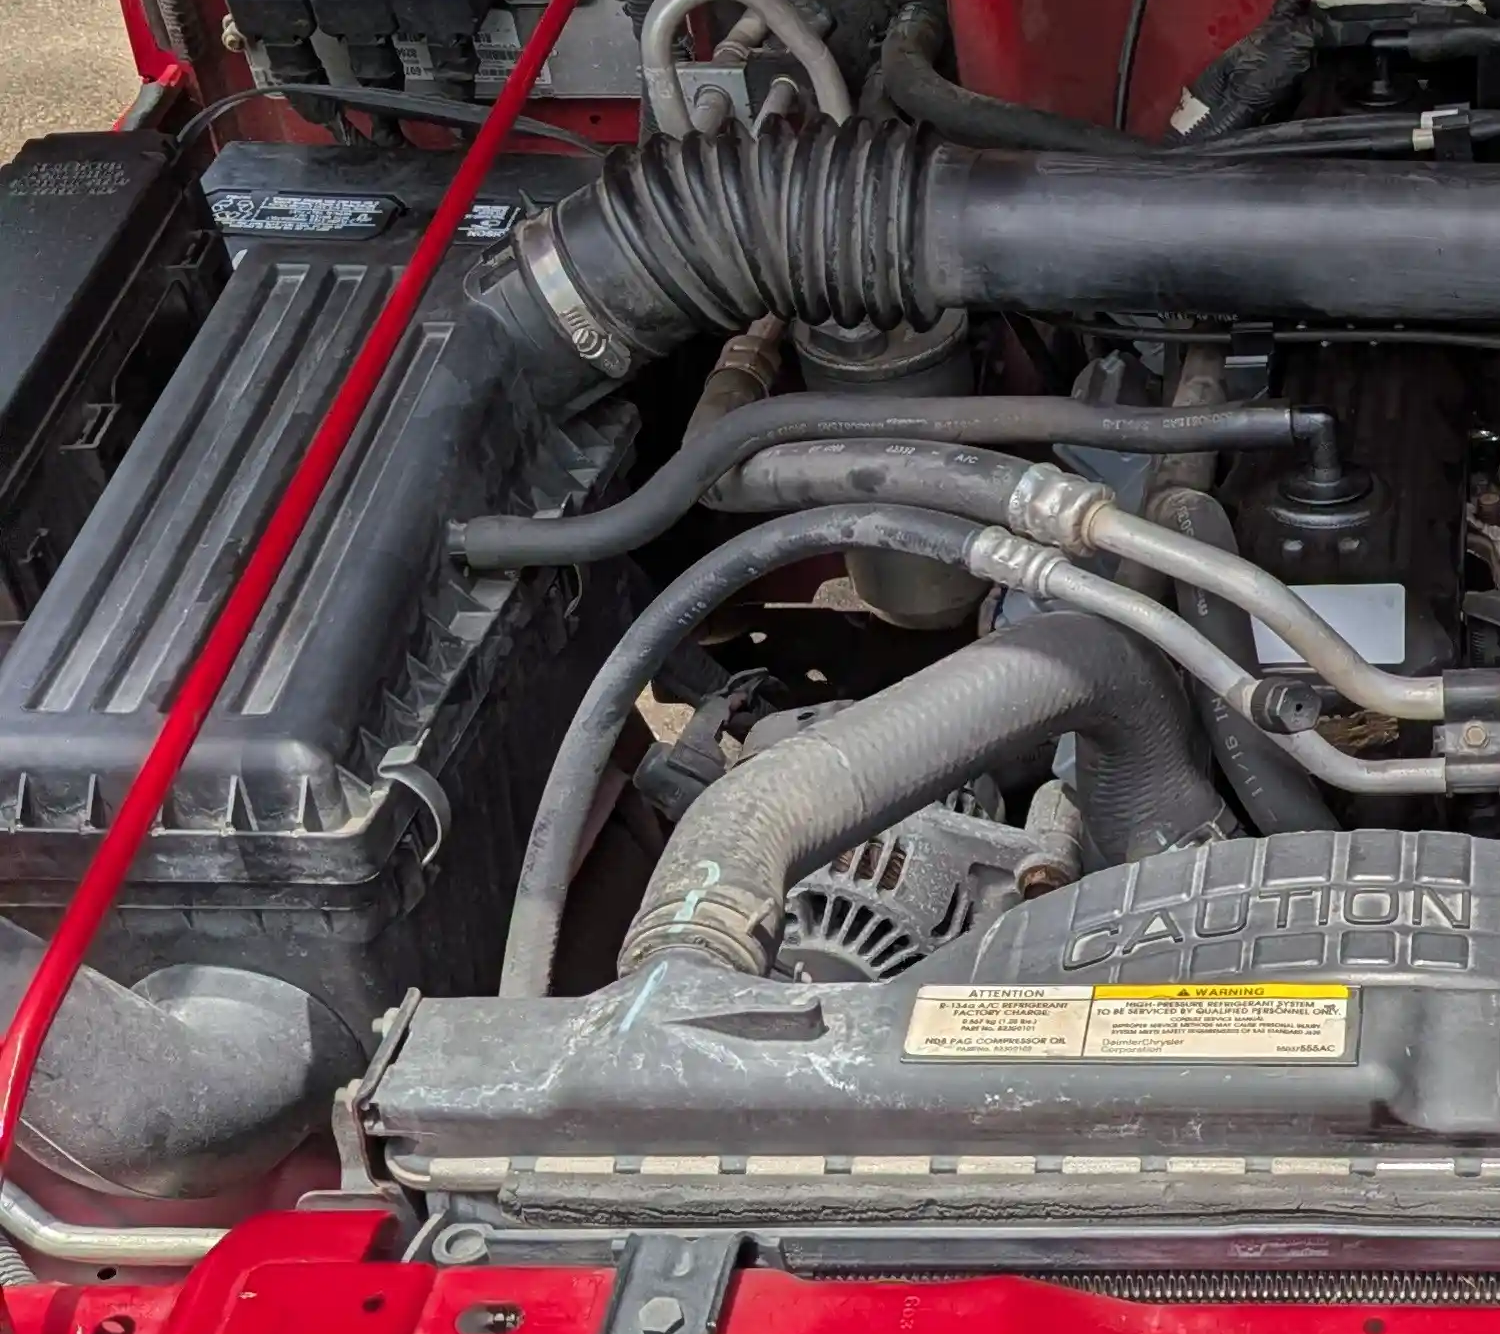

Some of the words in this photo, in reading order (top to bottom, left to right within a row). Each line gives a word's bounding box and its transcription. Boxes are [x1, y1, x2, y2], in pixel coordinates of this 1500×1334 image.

[1060, 884, 1472, 970] CAUTION
[968, 989, 1045, 998] ATTENTION
[1195, 987, 1265, 996] WARNING
[1207, 1000, 1275, 1008] REFRIGERANT
[1276, 1000, 1315, 1008] SYSTEM
[952, 1009, 1000, 1017] FACTORY
[1097, 1008, 1110, 1016] TO
[1195, 1007, 1249, 1015] QUALIFIED
[1252, 1007, 1310, 1016] PERSONNEL
[950, 1037, 972, 1045] PAG
[975, 1037, 1047, 1045] COMPRESSOR
[1049, 1037, 1066, 1045] OIL
[1102, 1038, 1184, 1047] DaimlerChrysler
[1100, 1046, 1163, 1054] Corporation
